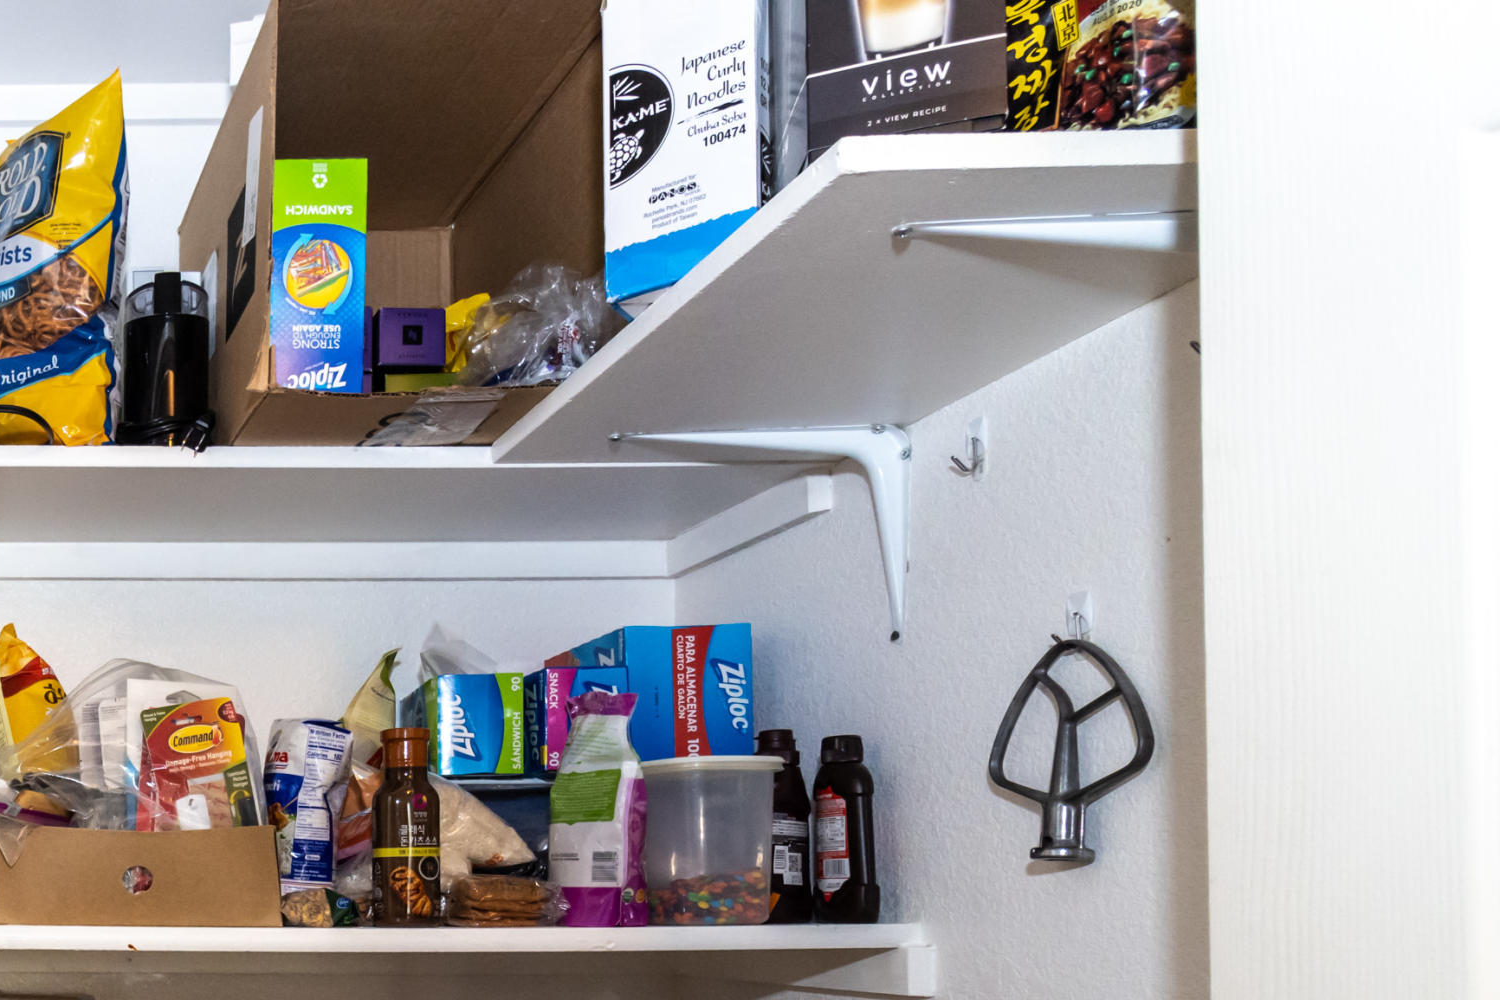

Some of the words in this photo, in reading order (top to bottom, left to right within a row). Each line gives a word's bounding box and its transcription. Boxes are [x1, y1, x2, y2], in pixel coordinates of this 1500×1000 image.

[681, 39, 746, 75] Japanese
[707, 57, 747, 82] Curly
[862, 61, 952, 96] view
[687, 80, 747, 110] Noodles
[862, 79, 952, 103] COLLECTION
[687, 119, 720, 138] Chuka
[721, 111, 747, 128] Soba
[867, 119, 873, 127] 2
[885, 112, 909, 124] VIEW
[912, 105, 947, 119] RECIPE
[703, 124, 747, 148] 100474
[285, 205, 353, 216] SANDWICH
[292, 324, 322, 332] AGAIN
[307, 332, 341, 340] ENOUGH
[324, 324, 341, 332] USE
[292, 339, 341, 350] STRONG
[287, 363, 348, 391] Ziploc
[676, 634, 684, 669] CUARTO
[686, 635, 696, 664] PARA
[511, 676, 521, 692] 90
[677, 672, 685, 684] DE
[549, 672, 559, 709] SNACK
[678, 686, 686, 719] GALÓN
[686, 665, 698, 732] ALMACENAR
[717, 663, 749, 729] Ziploc
[173, 730, 214, 747] Command
[448, 694, 476, 759] Ziploc
[207, 750, 232, 761] Hanging
[549, 751, 560, 767] 90
